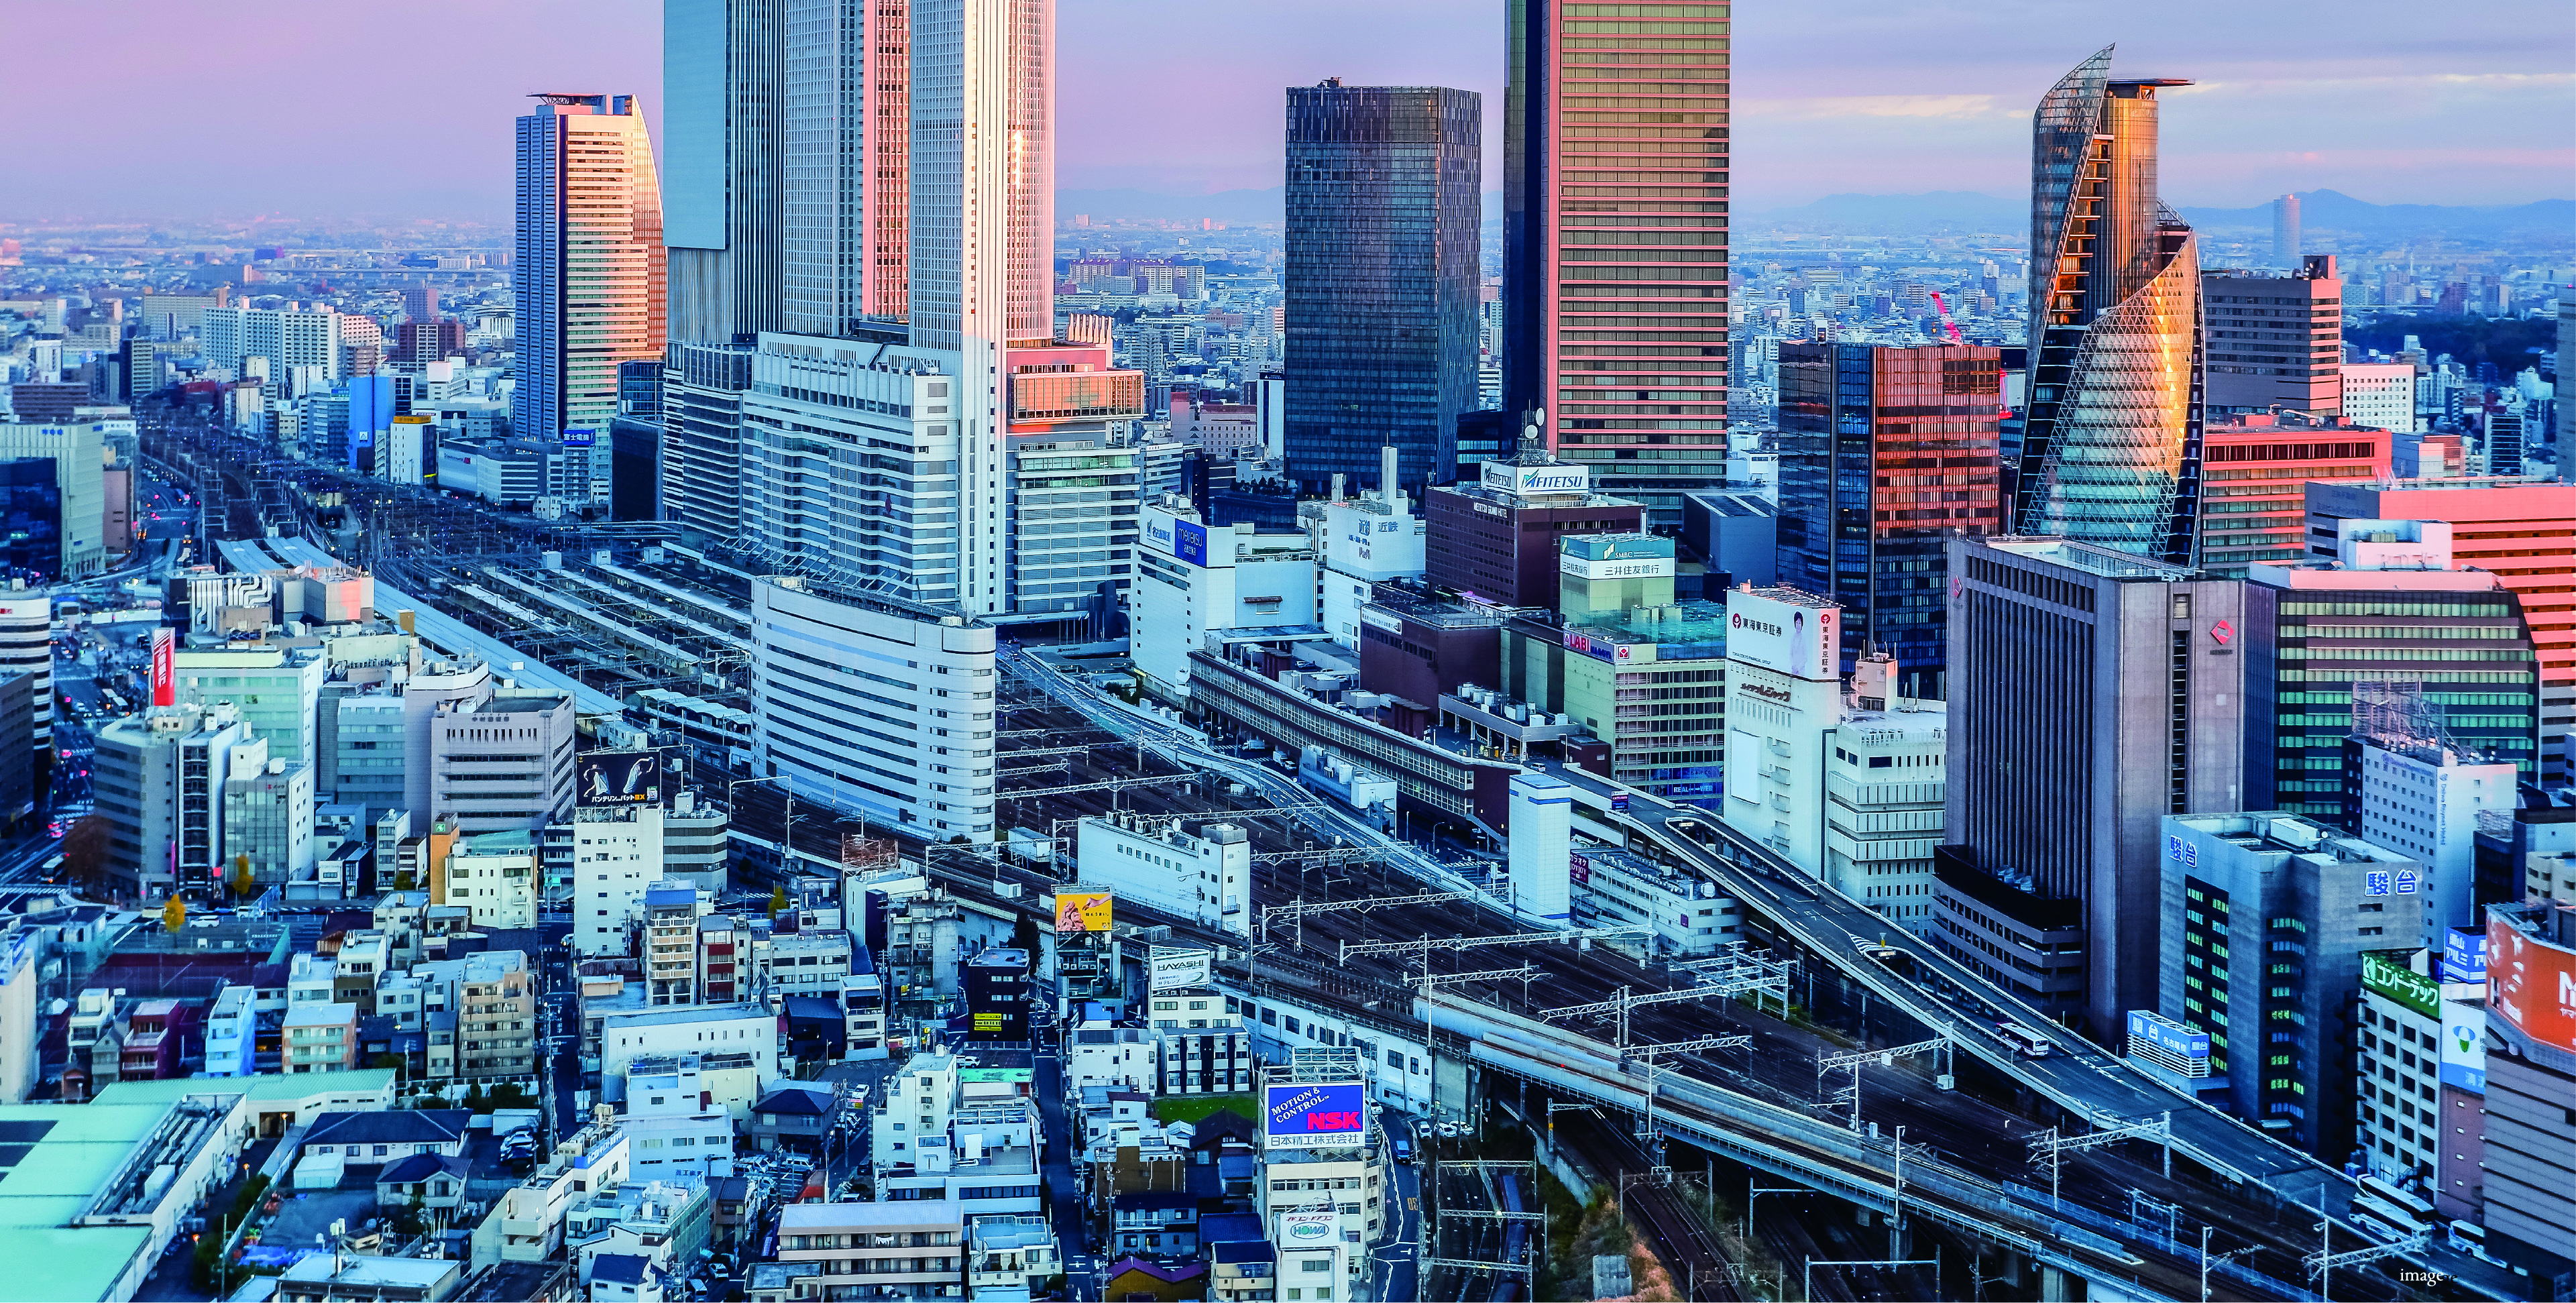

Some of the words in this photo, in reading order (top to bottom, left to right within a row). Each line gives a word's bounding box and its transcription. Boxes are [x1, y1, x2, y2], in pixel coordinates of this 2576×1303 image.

[1483, 464, 1512, 488] MEITETSU
[1521, 468, 1583, 488] MEITETSU
[1378, 521, 1398, 532] 近鉄
[1563, 561, 1587, 575] 三井住友銀行
[1605, 565, 1659, 575] 三井住友銀行
[1742, 618, 1782, 637] 東海東京証券
[1570, 633, 1591, 653] LABI
[2169, 835, 2198, 868] 駿台
[2365, 869, 2417, 897] 駿台
[1157, 960, 1205, 971] HAYASHI
[2446, 947, 2468, 966] アルミ
[2377, 964, 2438, 1007] コンドーテック
[2133, 1016, 2158, 1041] 駿台
[1271, 1090, 1312, 1115] MOTION
[1312, 1086, 1321, 1094] &
[1276, 1095, 1325, 1123] CONTROL
[1307, 1111, 1361, 1130] NSK
[1271, 1134, 1359, 1146] 日本精工株式会社
[1294, 1225, 1326, 1235] HOWA
